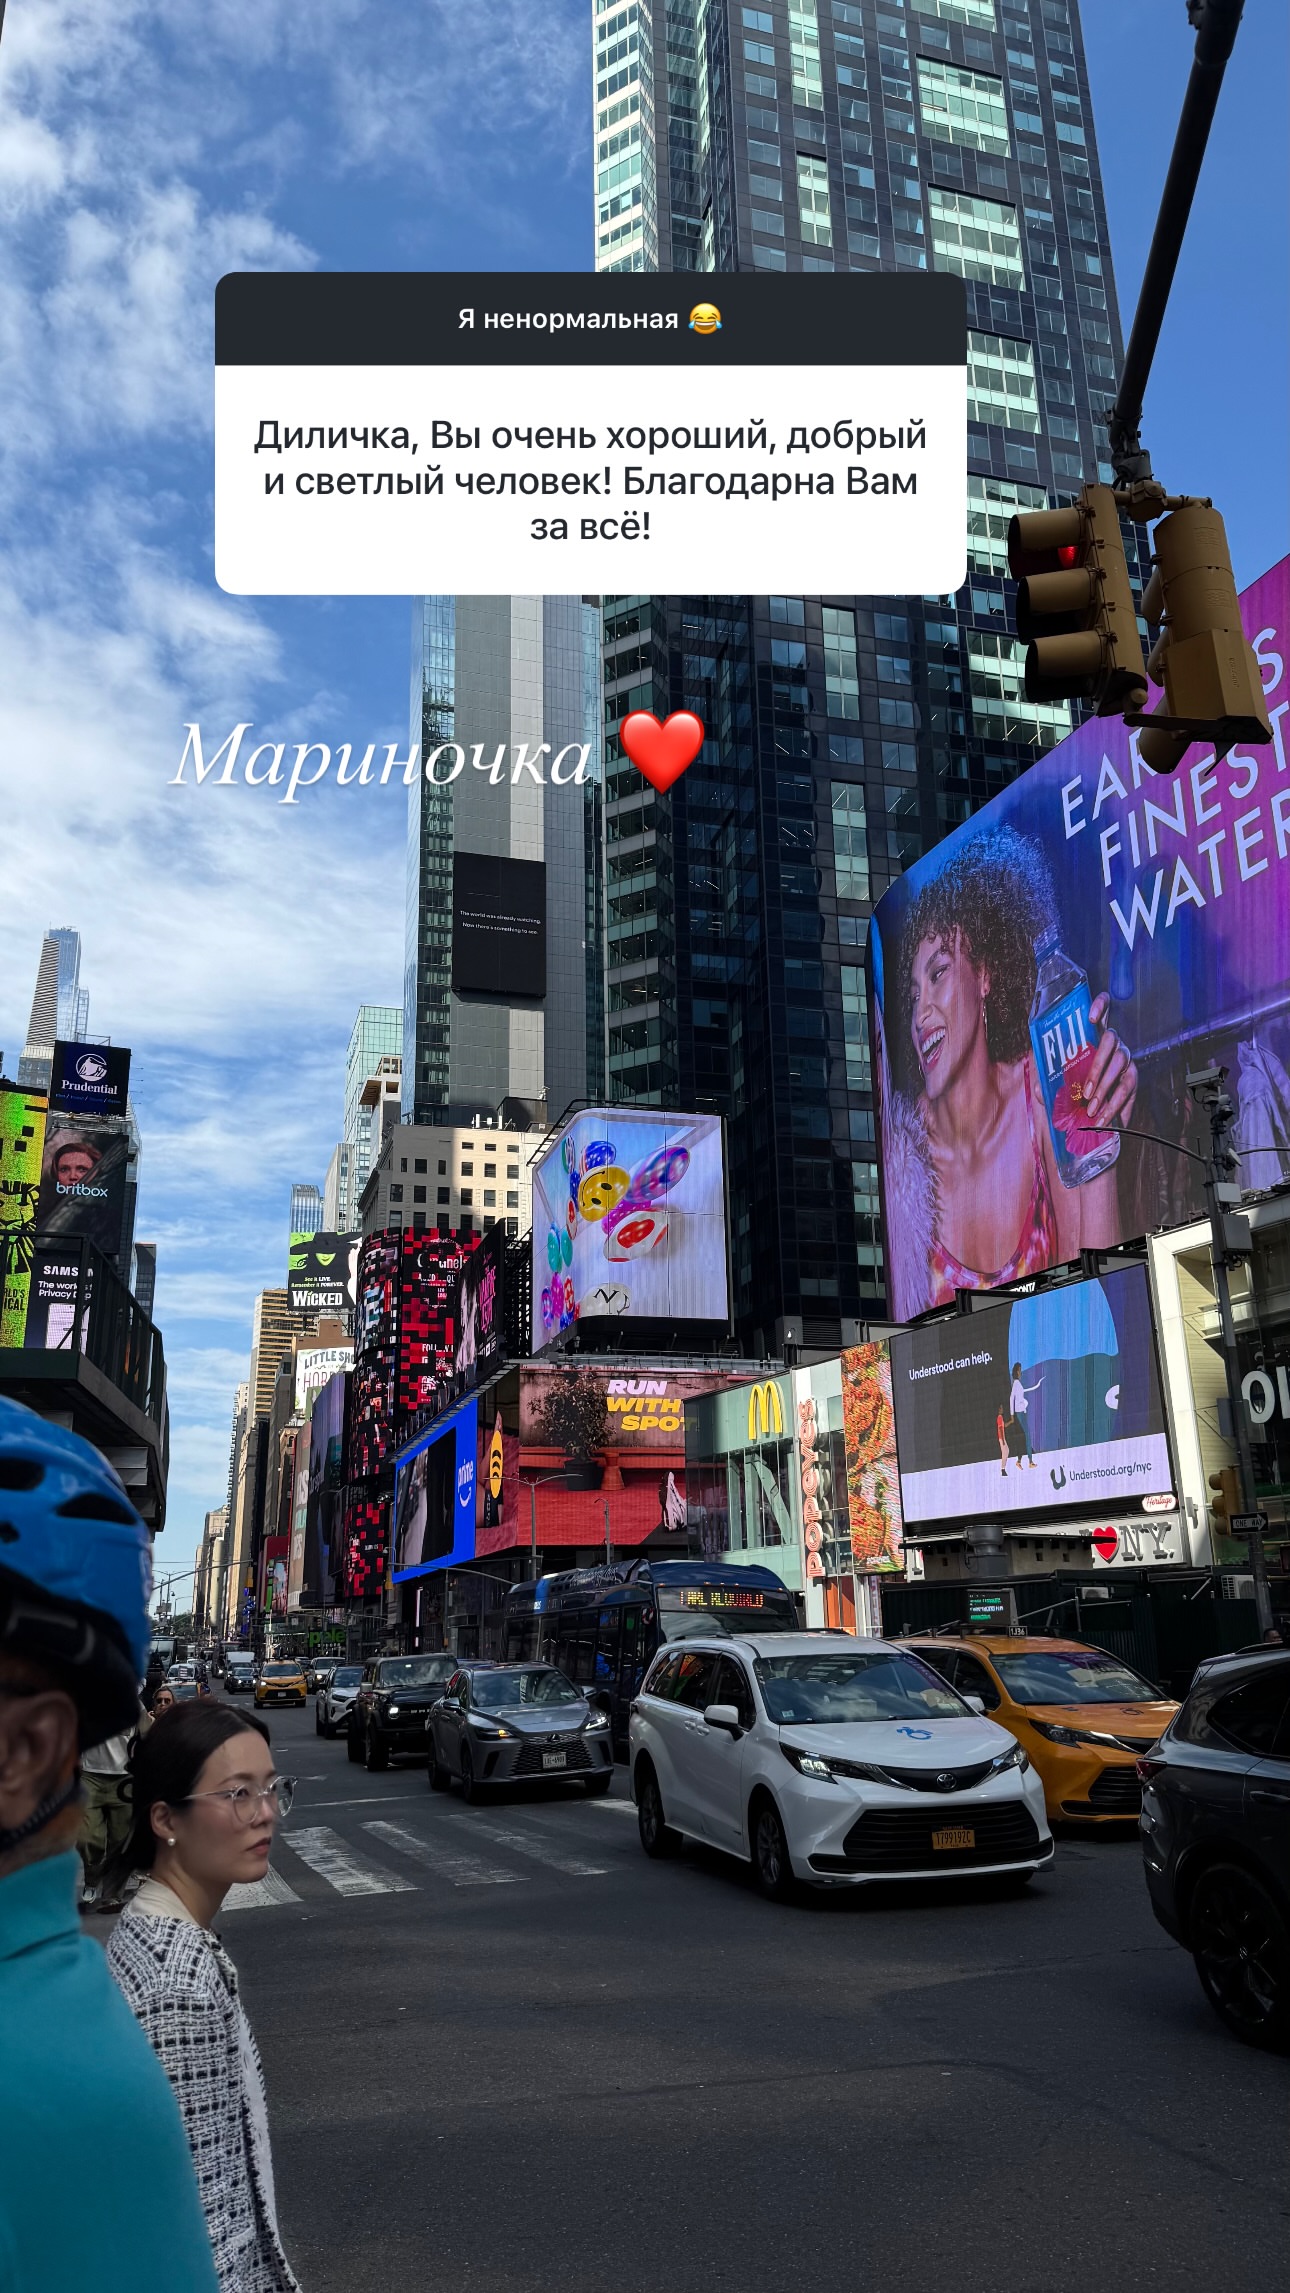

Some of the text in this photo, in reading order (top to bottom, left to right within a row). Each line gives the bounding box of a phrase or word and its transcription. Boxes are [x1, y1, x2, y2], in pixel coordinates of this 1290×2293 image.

[1061, 627, 1284, 840] EARS
[1042, 1006, 1089, 1077] FIJI
[61, 1079, 118, 1095] Prudential
[56, 1181, 109, 1198] britbox
[38, 1280, 55, 1289] The
[38, 1288, 72, 1300] Privacy
[304, 1350, 337, 1370] LITTLE
[908, 1350, 993, 1381] Understood can help.
[607, 1379, 668, 1396] RUN
[606, 1396, 682, 1413] WITH
[458, 1458, 474, 1493] prime
[1069, 1461, 1152, 1481] Understood.org/nyc
[1235, 1517, 1263, 1528] ONE WAY
